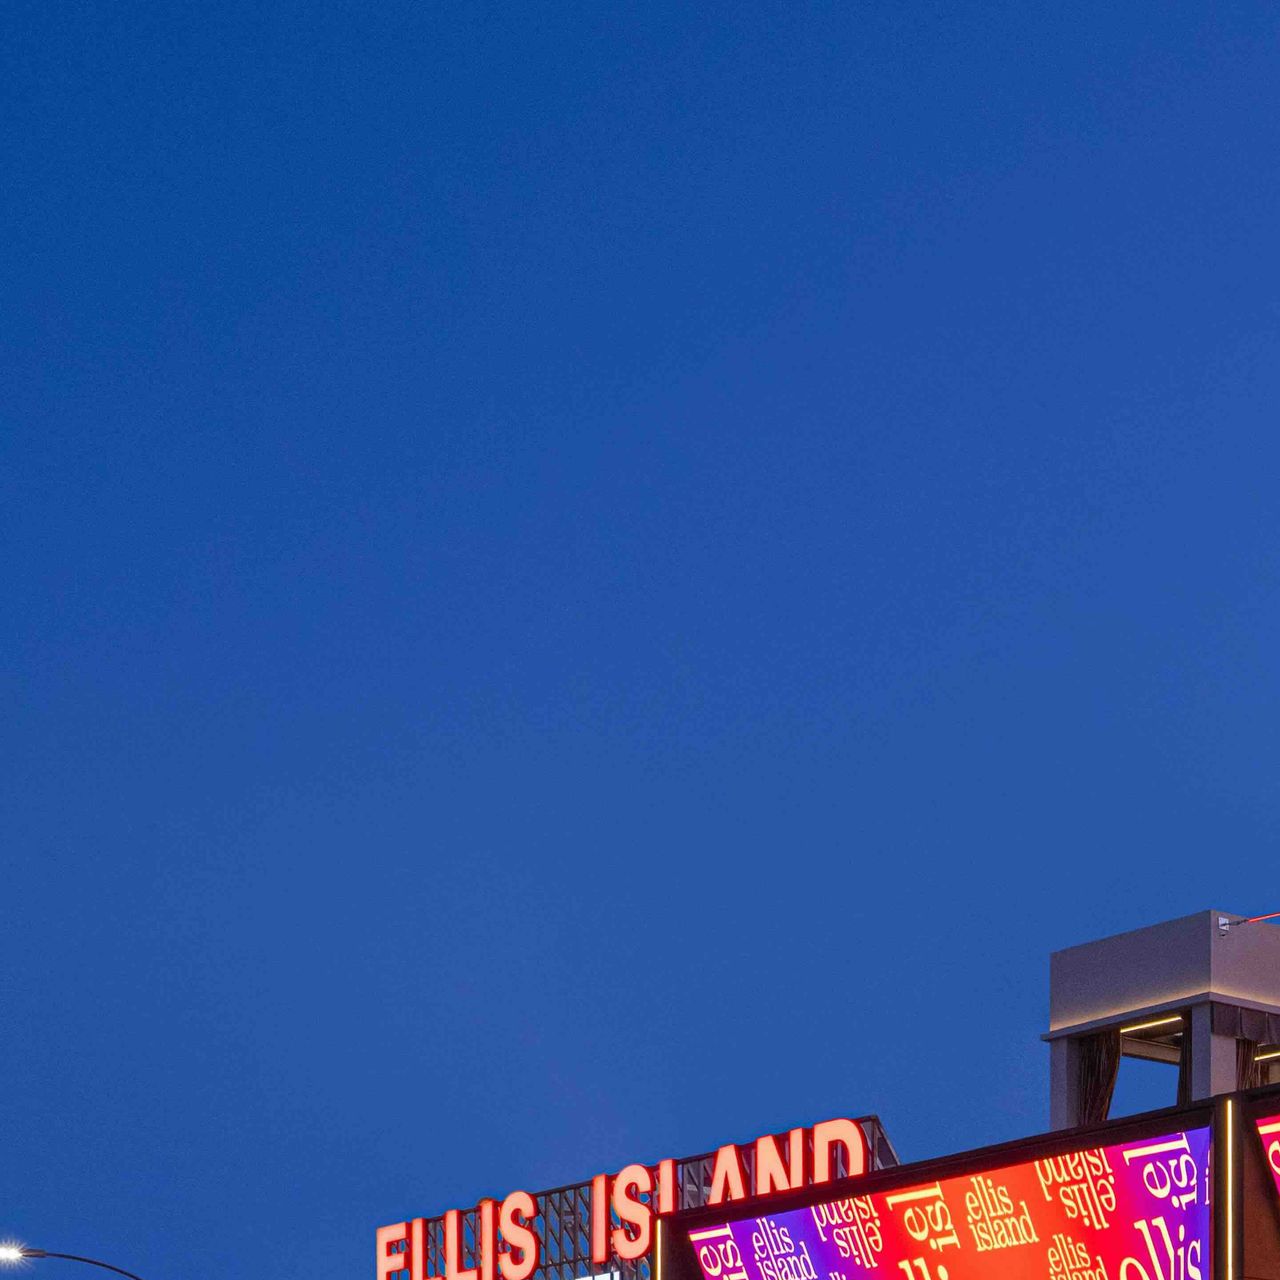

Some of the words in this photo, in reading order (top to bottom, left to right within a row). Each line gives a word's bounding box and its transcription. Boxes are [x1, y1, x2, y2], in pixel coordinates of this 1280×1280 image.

[965, 1176, 1014, 1220] ellis
[1059, 1179, 1116, 1230] ellis
[752, 1217, 794, 1258] ellis
[833, 1222, 883, 1269] ellis
[967, 1201, 1039, 1251] island
[1047, 1234, 1091, 1272] ellis
